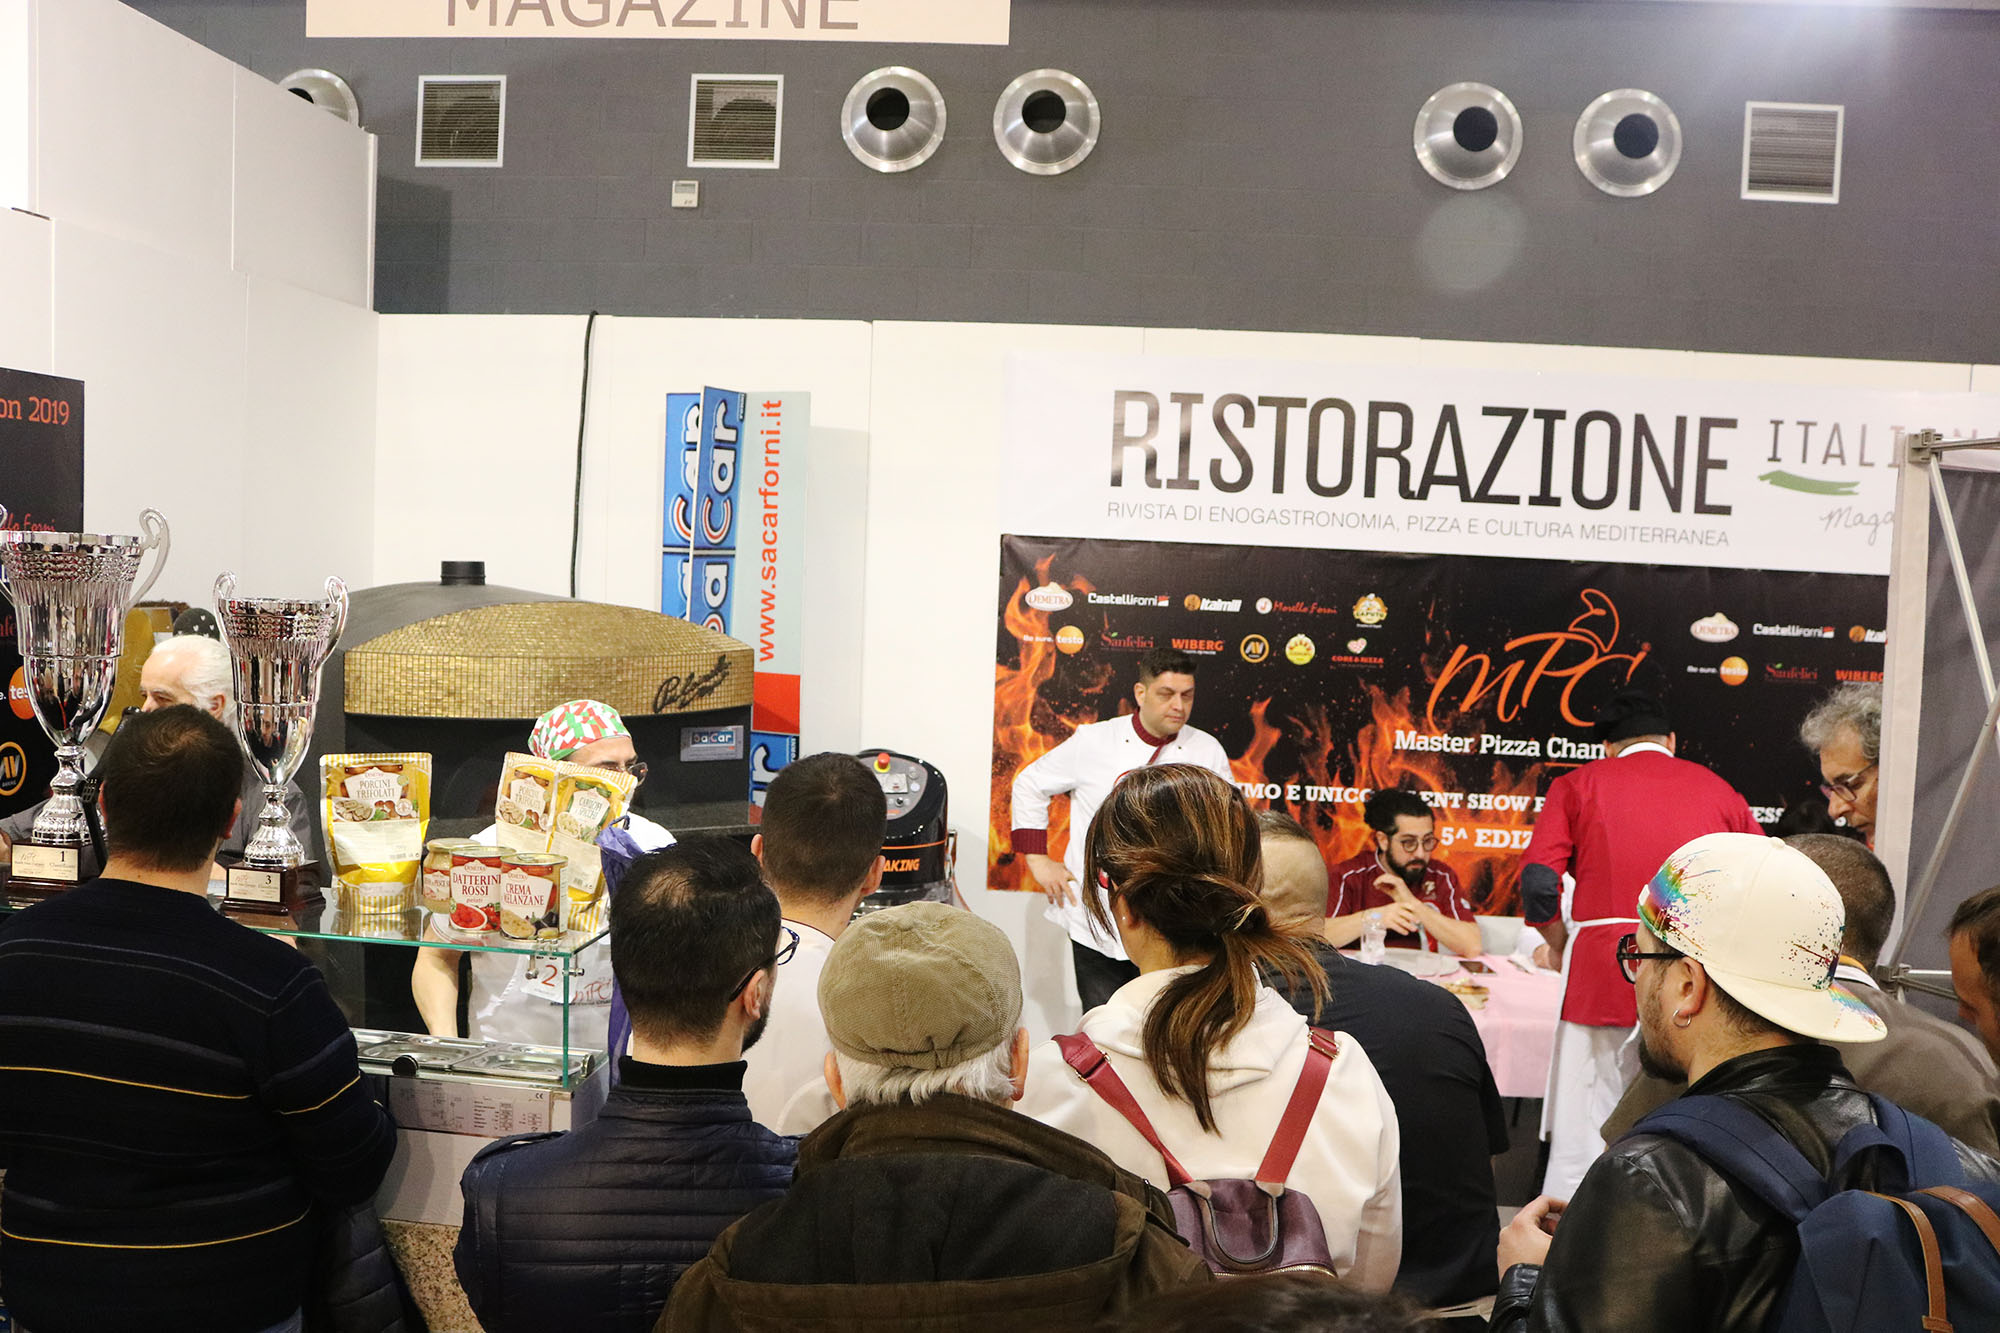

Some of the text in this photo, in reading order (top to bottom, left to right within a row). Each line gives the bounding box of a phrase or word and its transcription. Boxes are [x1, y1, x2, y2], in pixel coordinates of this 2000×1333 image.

[28, 396, 70, 426] 2019
[1110, 389, 1738, 516] RISTORAZIONE
[1107, 501, 1730, 546] RIVISTA DI ENOGASTRONOMIA, PIZZA E CULTURA MEDITERRANEA
[759, 399, 782, 663] www.sacarforni.it
[1056, 634, 1084, 645] testo
[1171, 638, 1224, 652] WIBERG
[1394, 730, 1475, 753] Master
[1479, 734, 1542, 757] Pizza
[359, 779, 391, 790] PORCINI
[356, 788, 395, 799] TRIFOLATI
[1284, 784, 1301, 802] E
[1467, 793, 1531, 812] SHOW
[60, 850, 65, 862] 1
[884, 858, 920, 872] AKING
[265, 875, 272, 885] 3
[453, 872, 501, 886] DATTERINI
[462, 886, 489, 896] ROSSI
[505, 883, 531, 895] CREMA
[541, 964, 558, 987] 2
